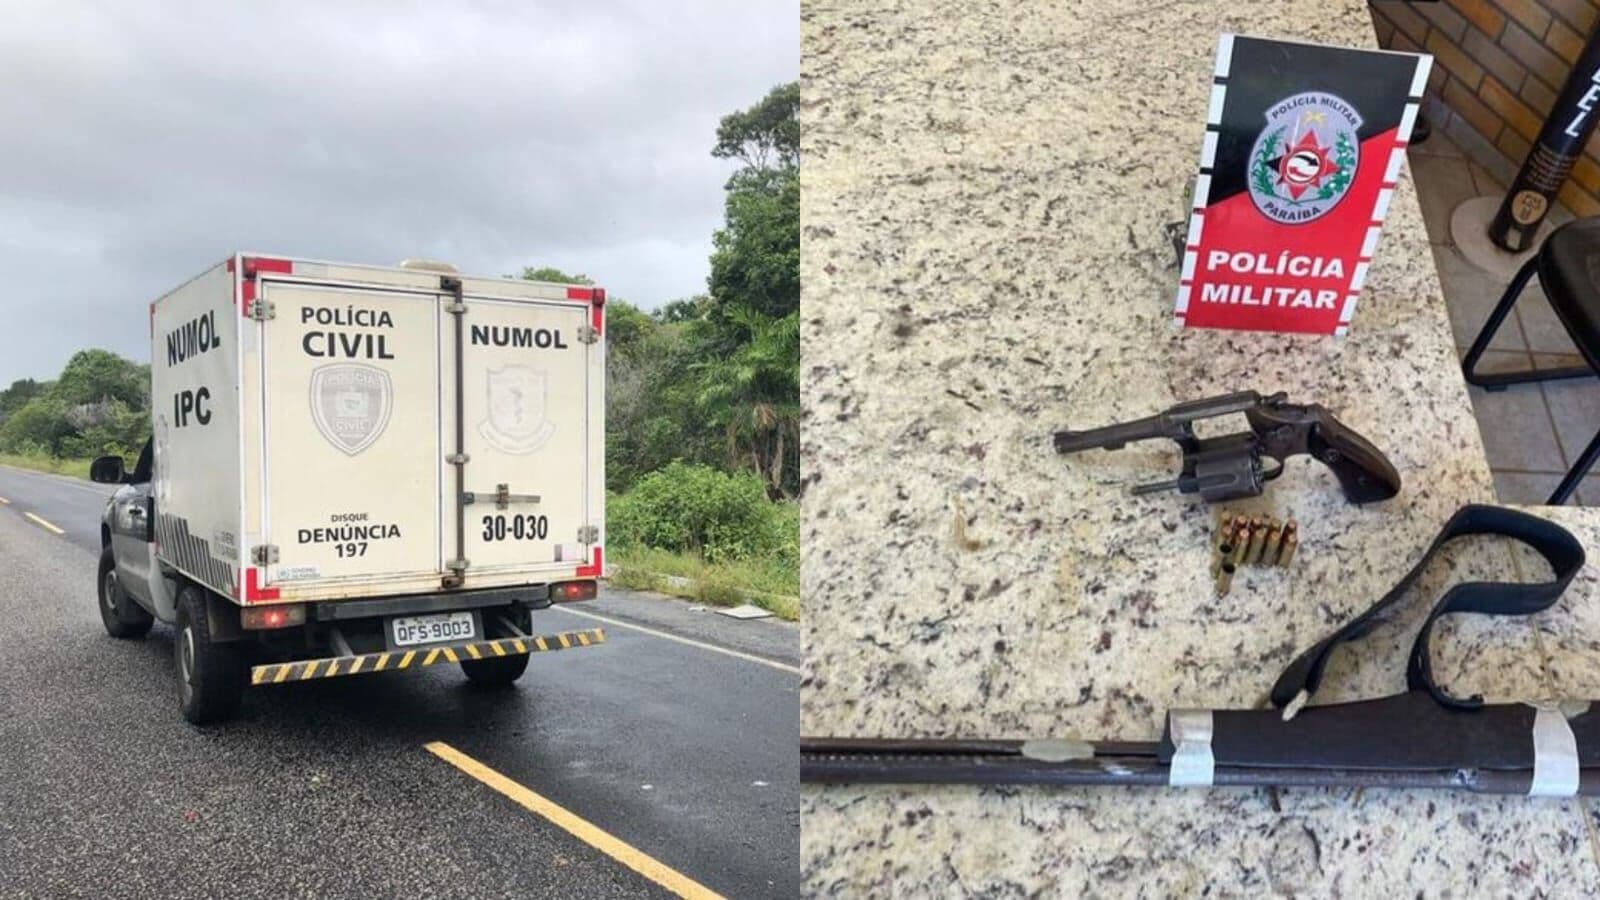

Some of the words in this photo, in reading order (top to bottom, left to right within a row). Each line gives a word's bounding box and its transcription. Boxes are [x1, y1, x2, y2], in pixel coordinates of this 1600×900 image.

[1320, 97, 1358, 126] MILITAR
[1565, 67, 1600, 137] EL
[1206, 249, 1345, 279] POLÍCIA
[1200, 282, 1339, 310] MILITAR
[300, 304, 394, 328] POLÍCIA
[166, 309, 221, 369] NUMOL
[302, 330, 395, 360] CIVIL
[471, 324, 568, 349] NUMOL
[173, 385, 212, 429] IPC
[330, 512, 369, 523] DISQUE
[482, 513, 548, 542] 30-030
[297, 522, 402, 544] DENÚNCIA
[334, 542, 368, 558] 197
